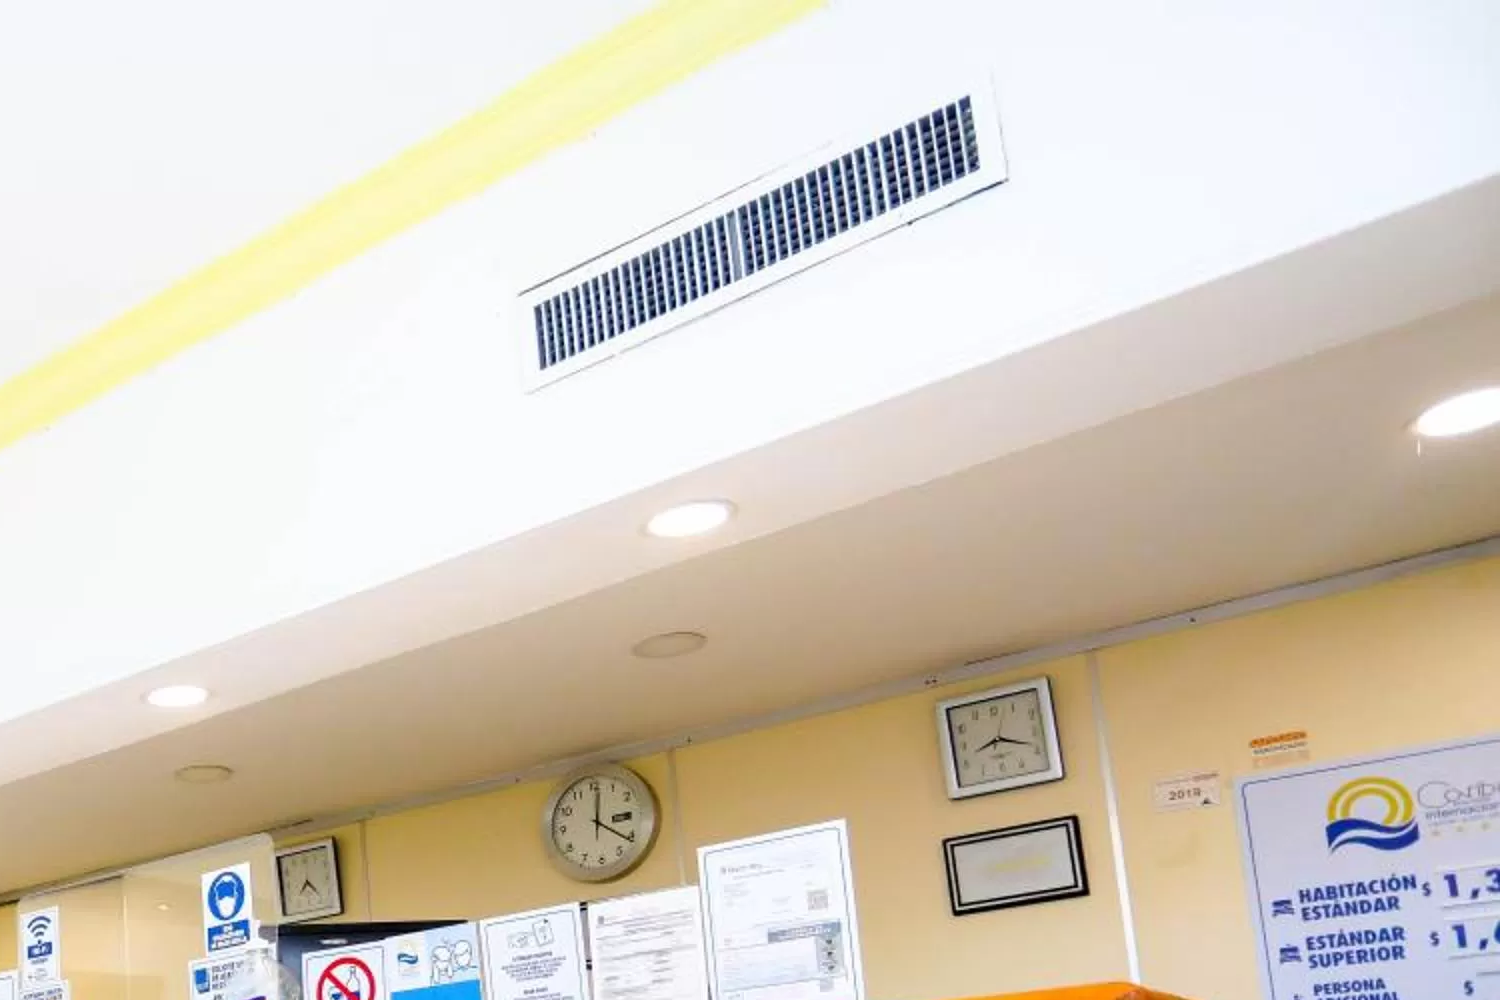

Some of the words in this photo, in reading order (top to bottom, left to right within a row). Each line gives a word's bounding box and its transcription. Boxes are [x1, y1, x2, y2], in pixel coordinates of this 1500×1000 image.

[1298, 872, 1417, 905] HABITACIÓN
[1421, 881, 1432, 897] $
[1429, 931, 1441, 948] $
[1308, 944, 1406, 969] SUPERIOR
[1313, 977, 1386, 997] PERSONA
